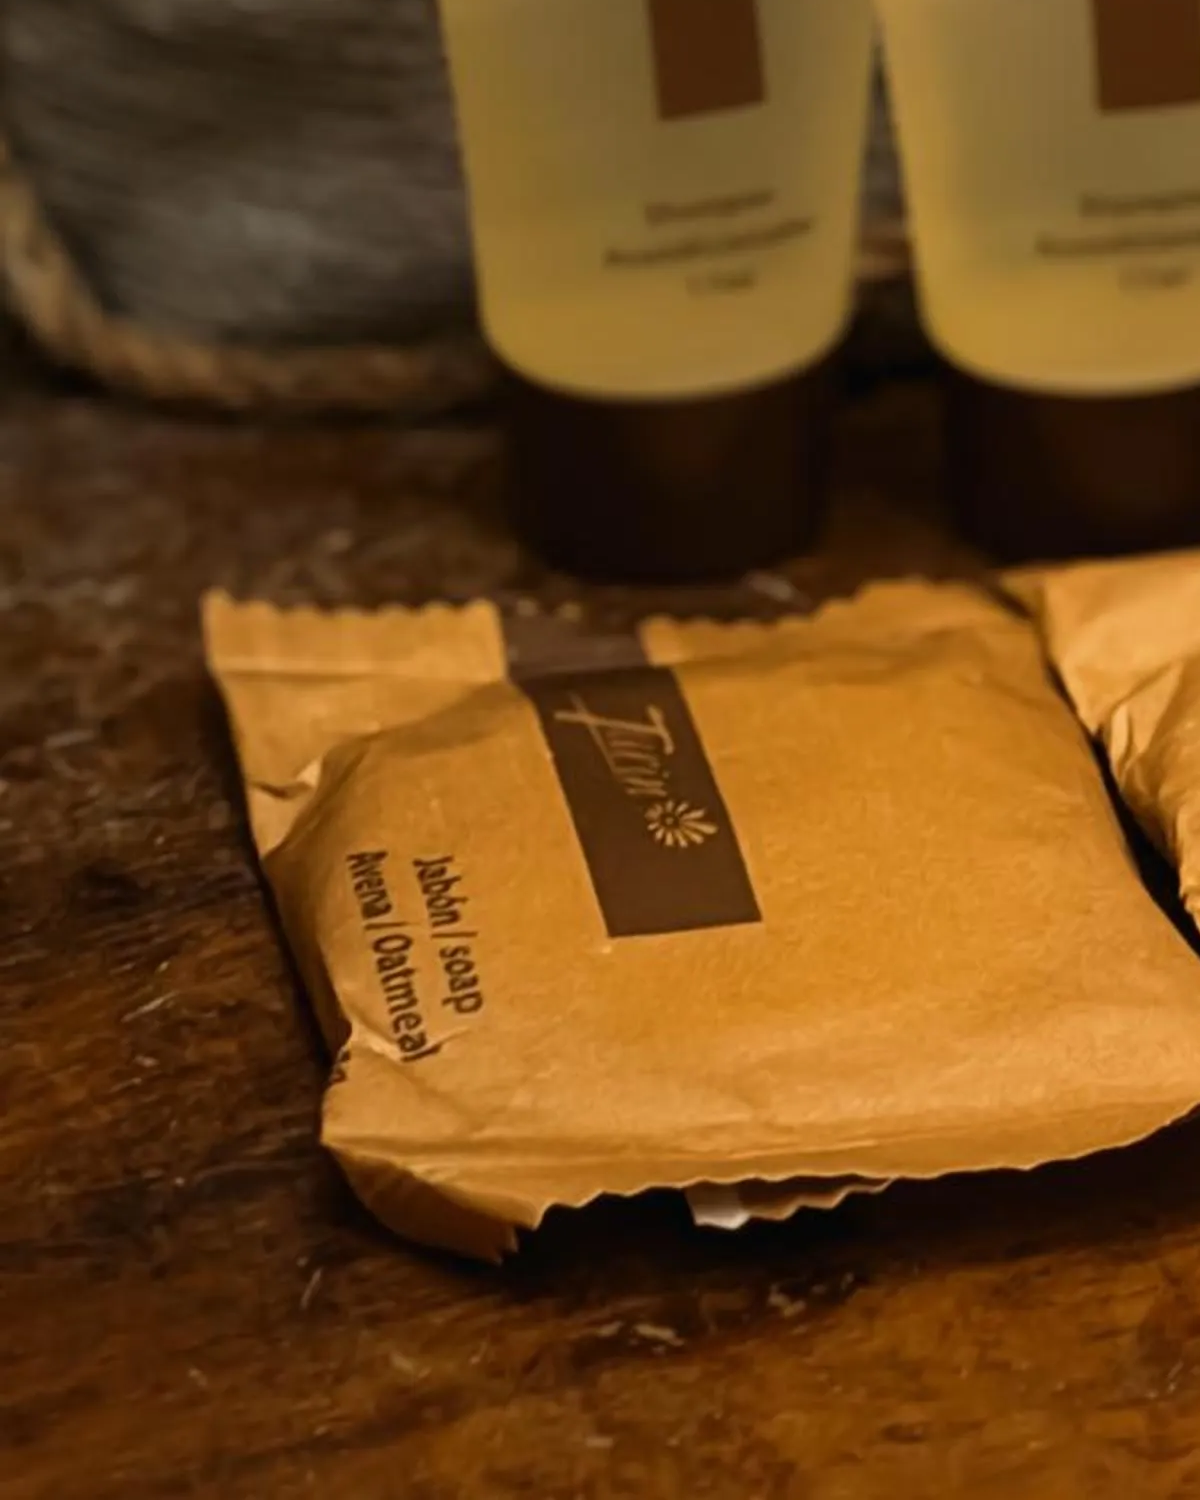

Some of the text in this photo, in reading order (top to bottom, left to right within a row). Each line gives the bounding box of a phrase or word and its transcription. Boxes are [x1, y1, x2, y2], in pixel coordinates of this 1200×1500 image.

[412, 854, 471, 929] Jabón
[346, 850, 390, 920] Avena
[372, 933, 443, 1063] Oatmeal
[438, 944, 484, 1015] soap
